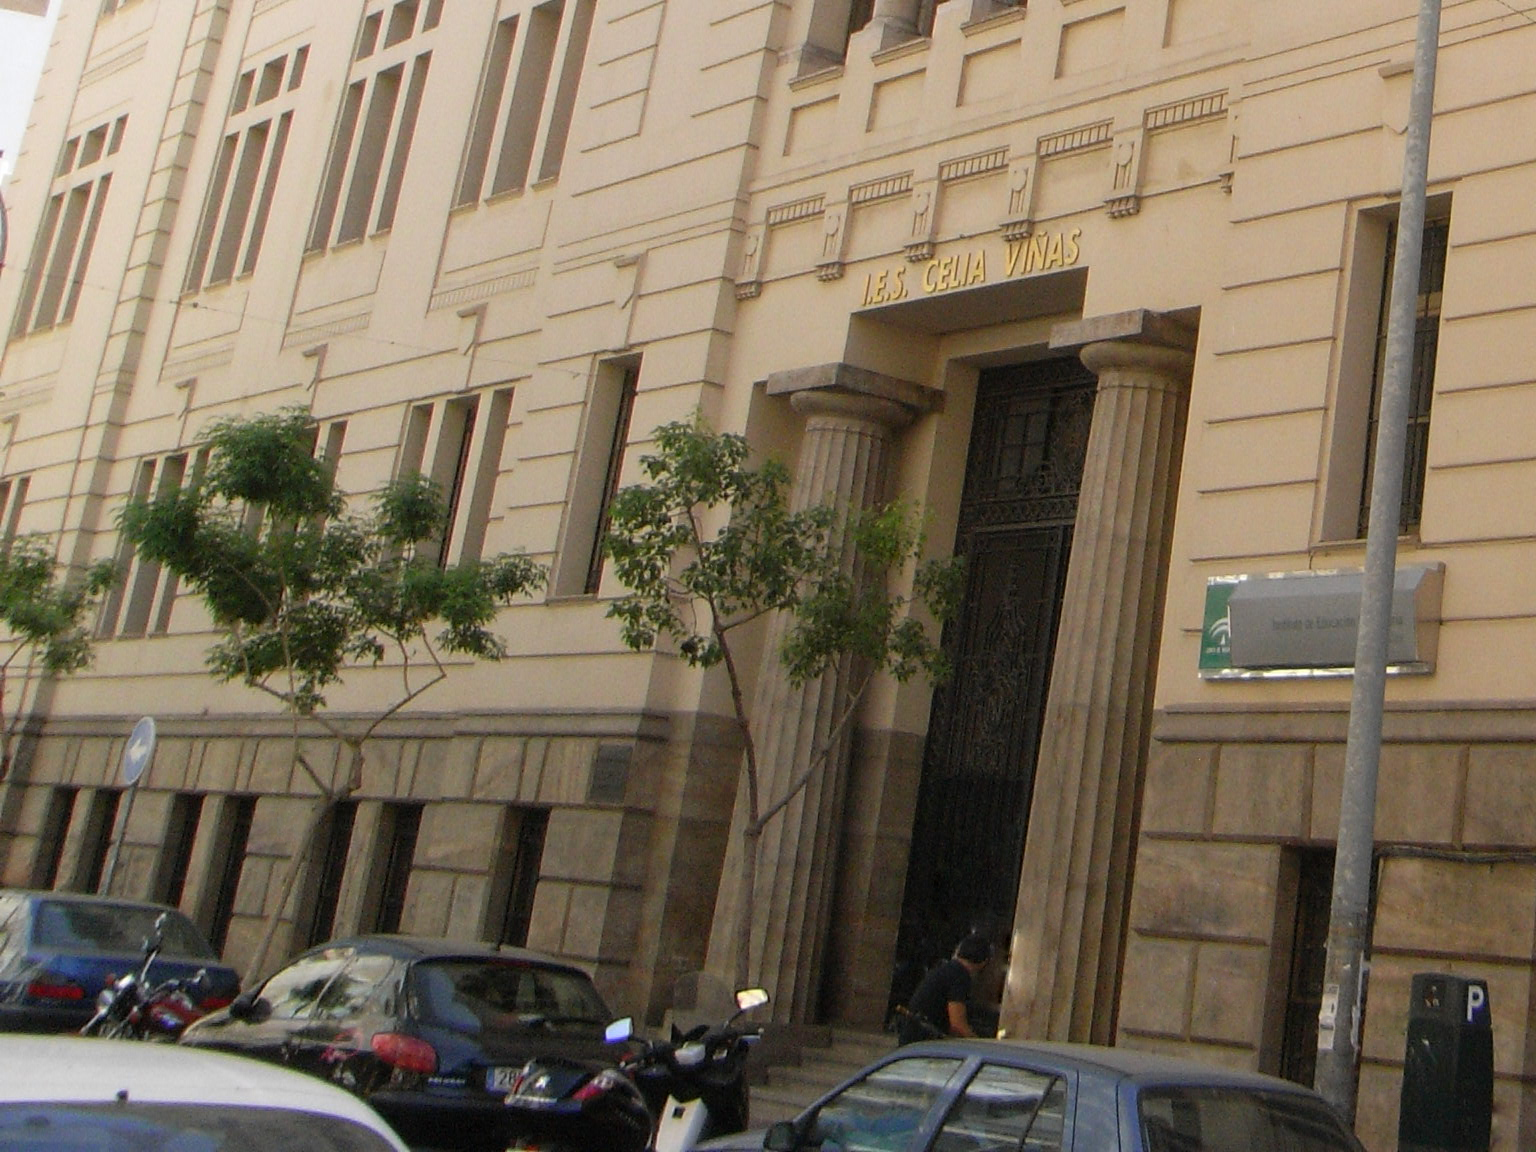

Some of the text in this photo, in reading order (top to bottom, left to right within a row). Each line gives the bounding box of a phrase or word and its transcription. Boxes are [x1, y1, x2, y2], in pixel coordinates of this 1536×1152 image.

[861, 228, 1082, 306] I.E.S. CELIA VIÑAS
[1467, 985, 1485, 1022] P
